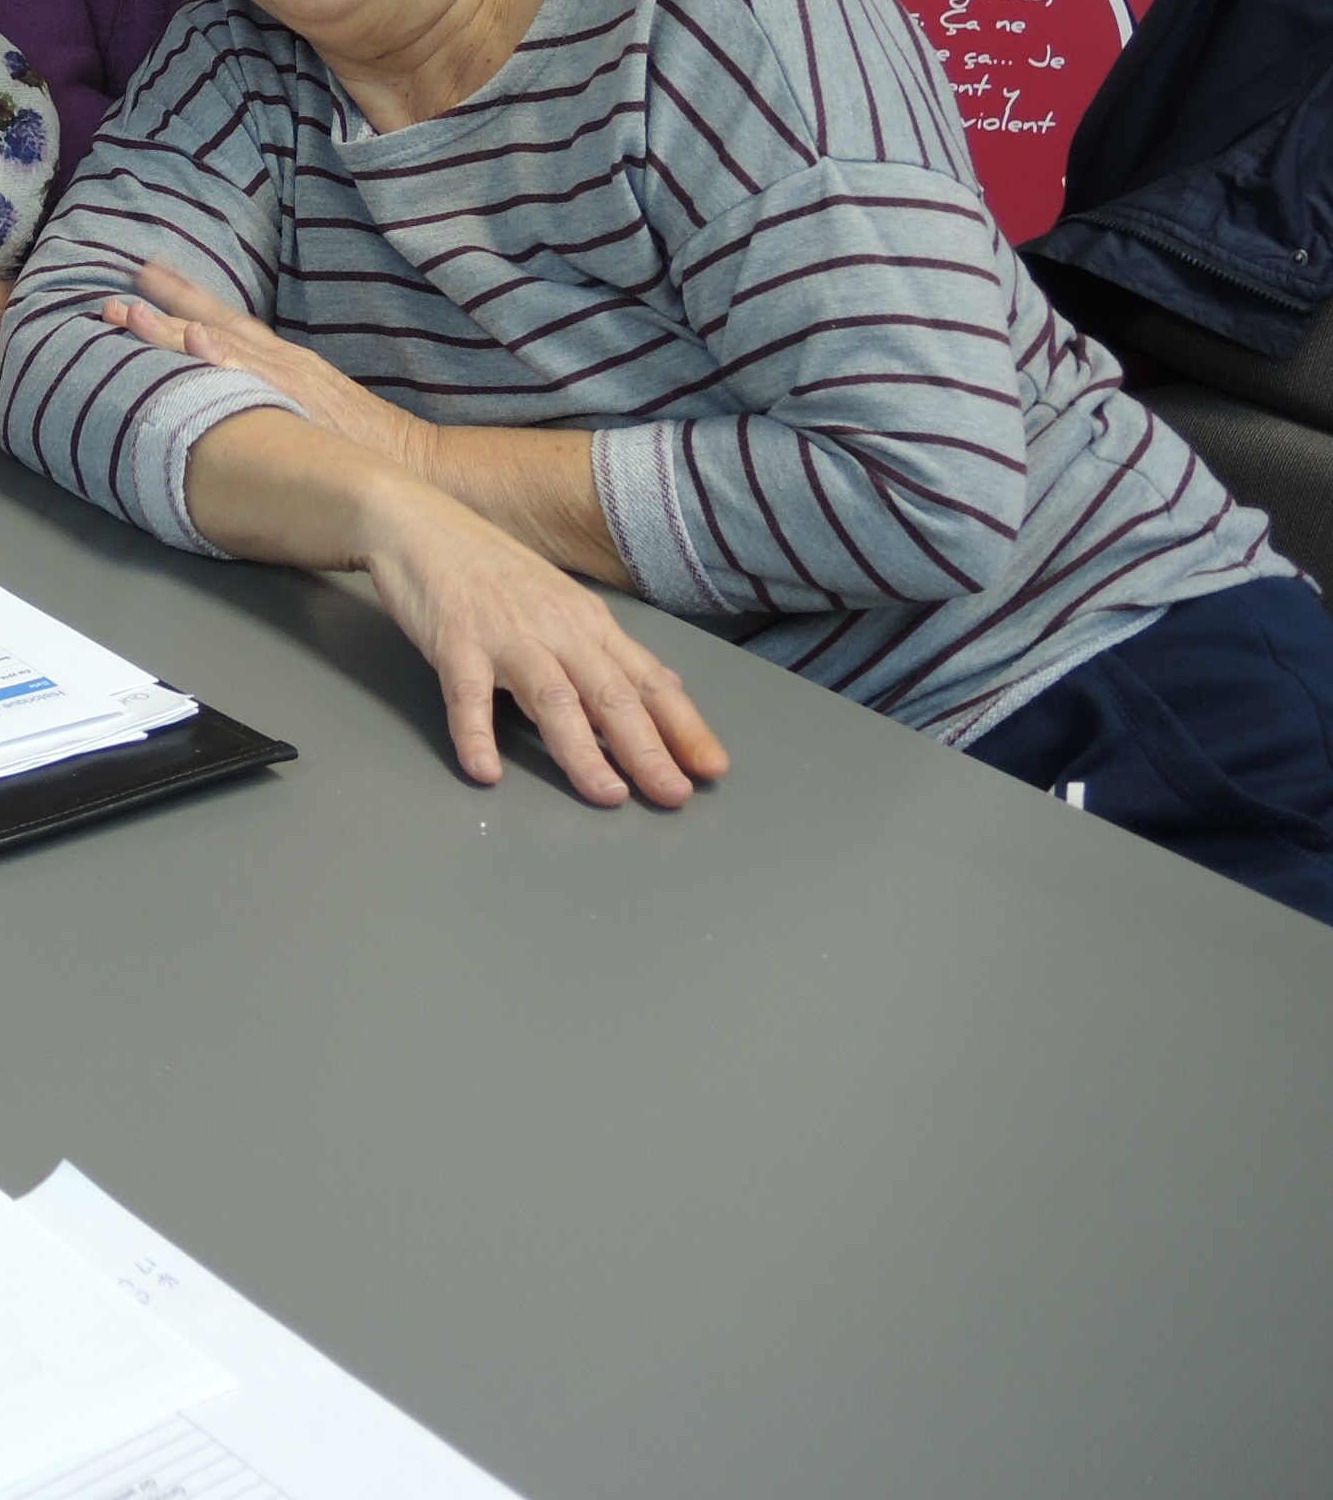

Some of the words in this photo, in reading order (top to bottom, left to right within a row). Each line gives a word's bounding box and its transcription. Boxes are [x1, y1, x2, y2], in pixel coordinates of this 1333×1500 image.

[940, 7, 981, 36] Ça
[996, 20, 1025, 33] ne
[1028, 44, 1065, 69] Je
